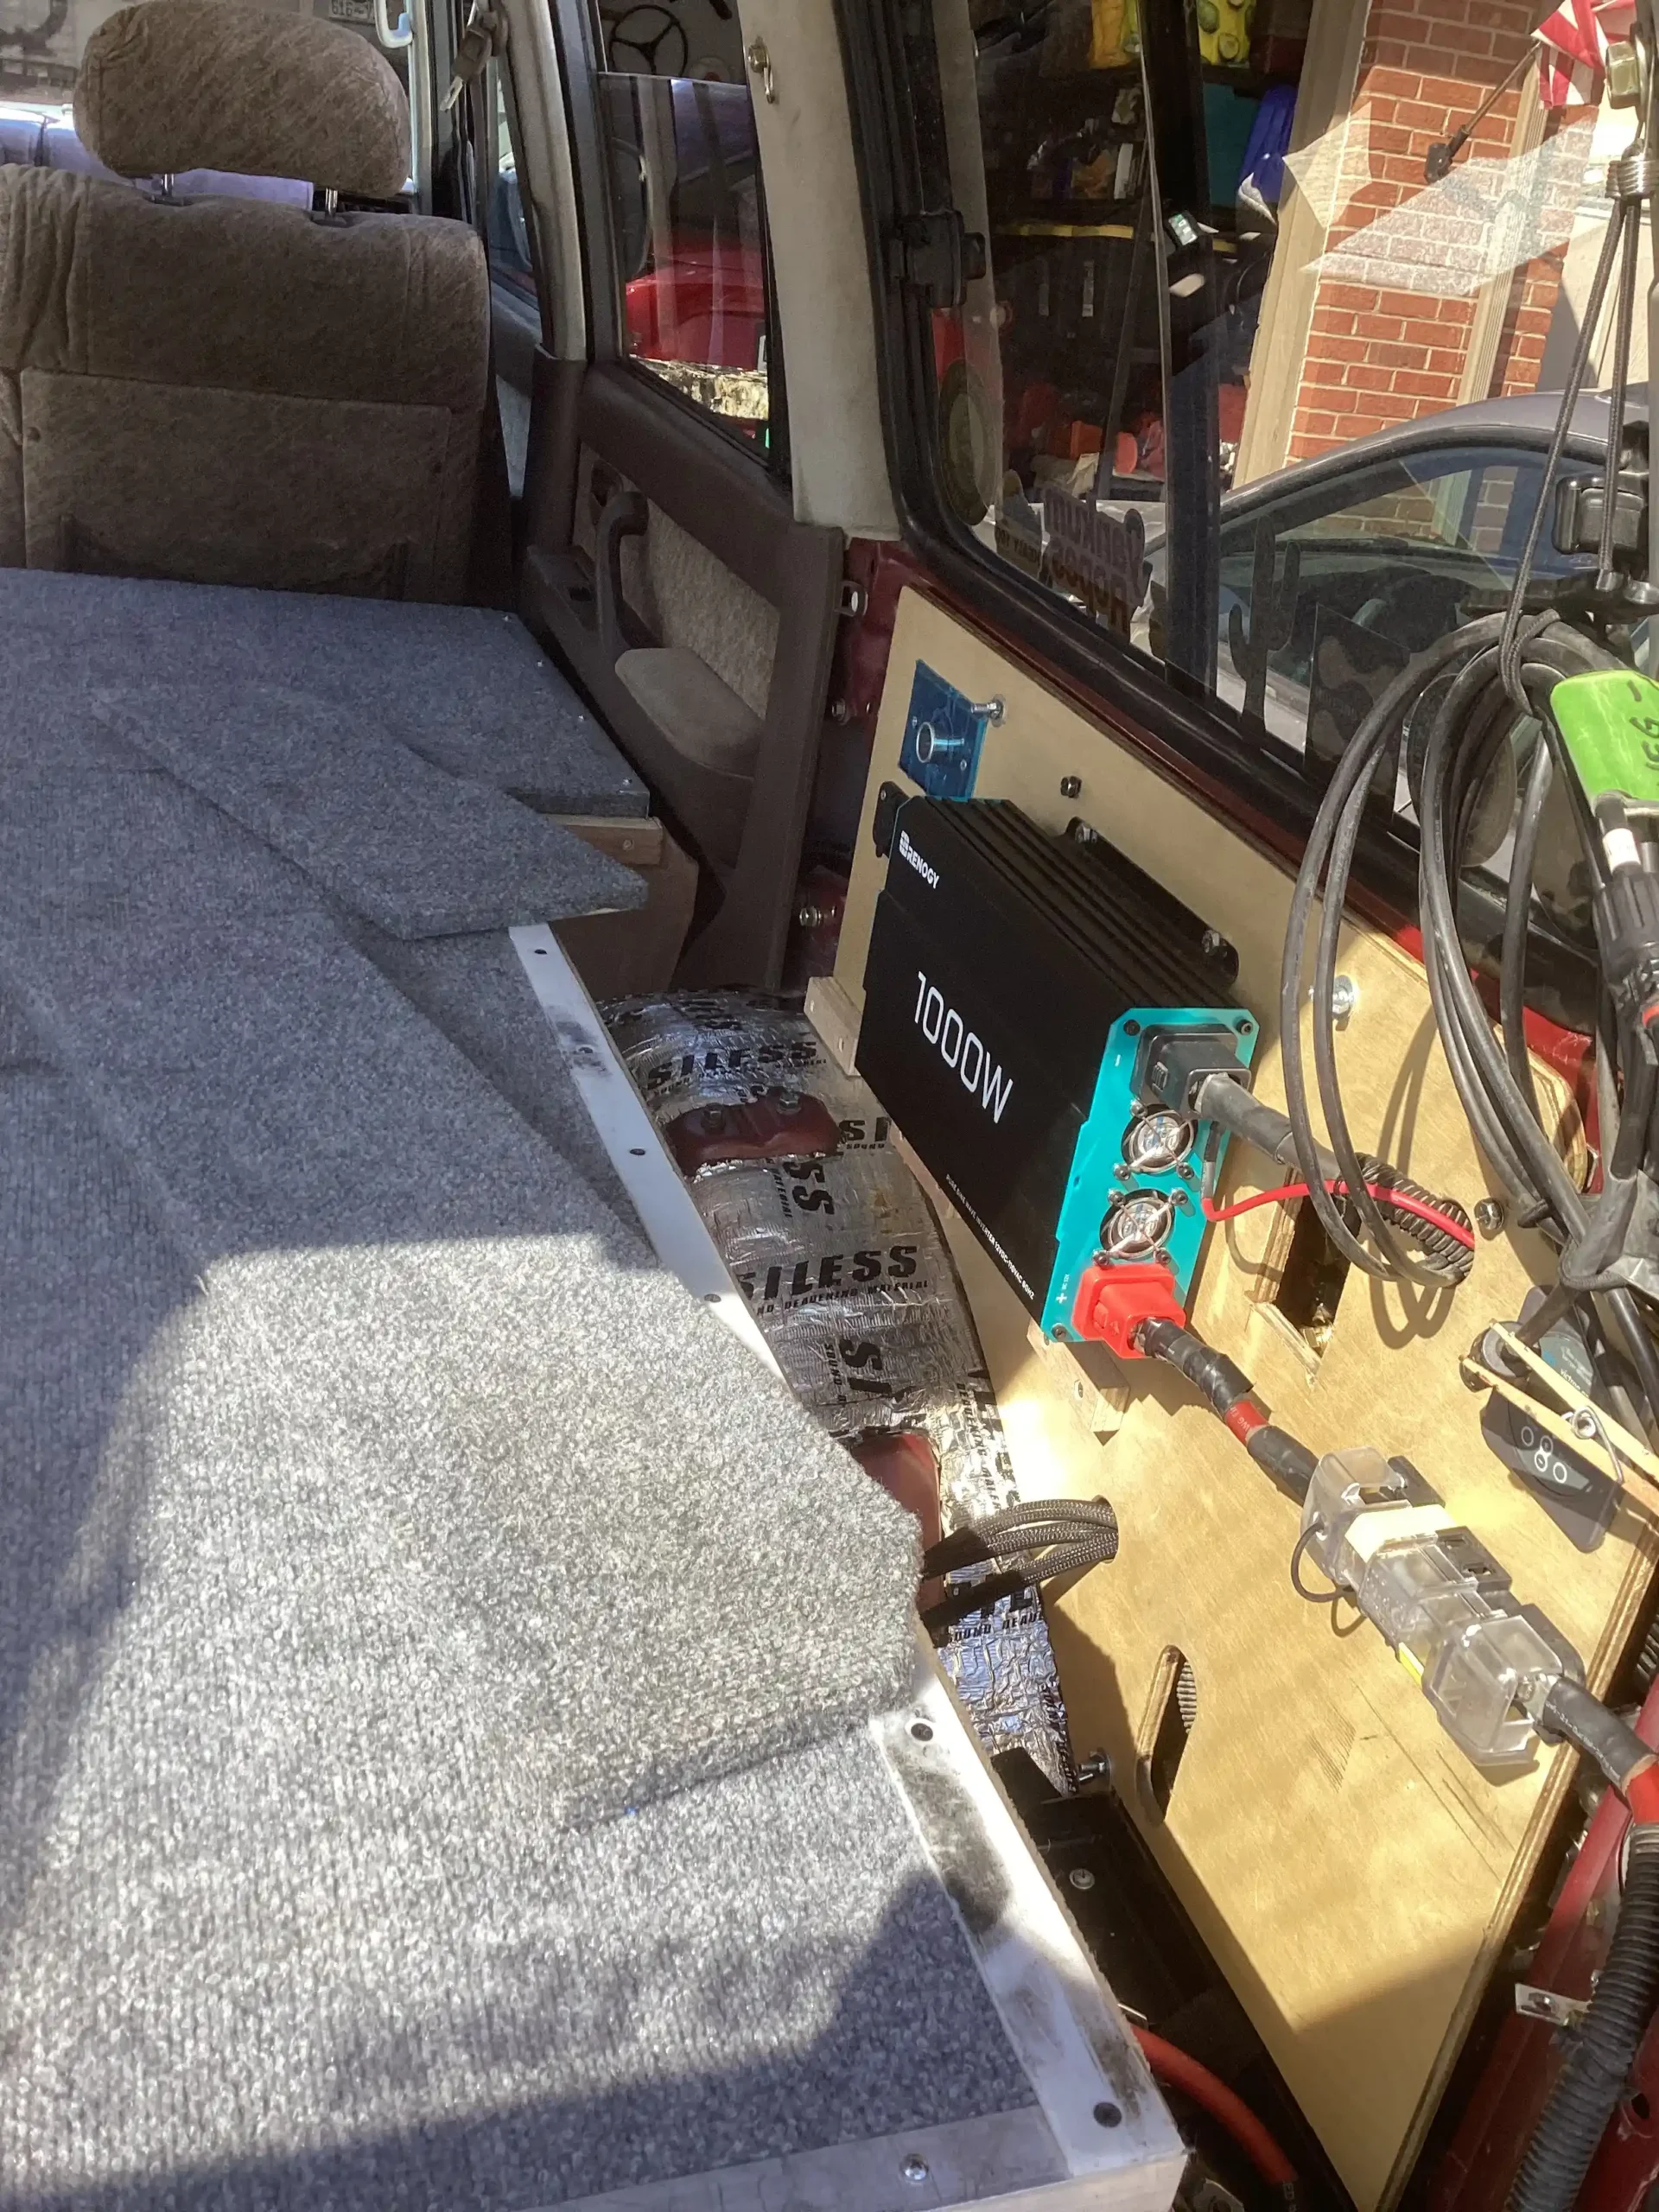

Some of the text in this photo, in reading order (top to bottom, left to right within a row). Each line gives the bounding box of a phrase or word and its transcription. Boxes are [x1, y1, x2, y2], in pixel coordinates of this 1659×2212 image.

[906, 845, 940, 889] RENOGY
[914, 970, 1014, 1124] 1000W
[976, 1215, 995, 1245] INVERTER
[784, 1287, 859, 1311] DEADENING
[868, 1280, 929, 1295] MATERIAL
[823, 1343, 843, 1387] SOUND
